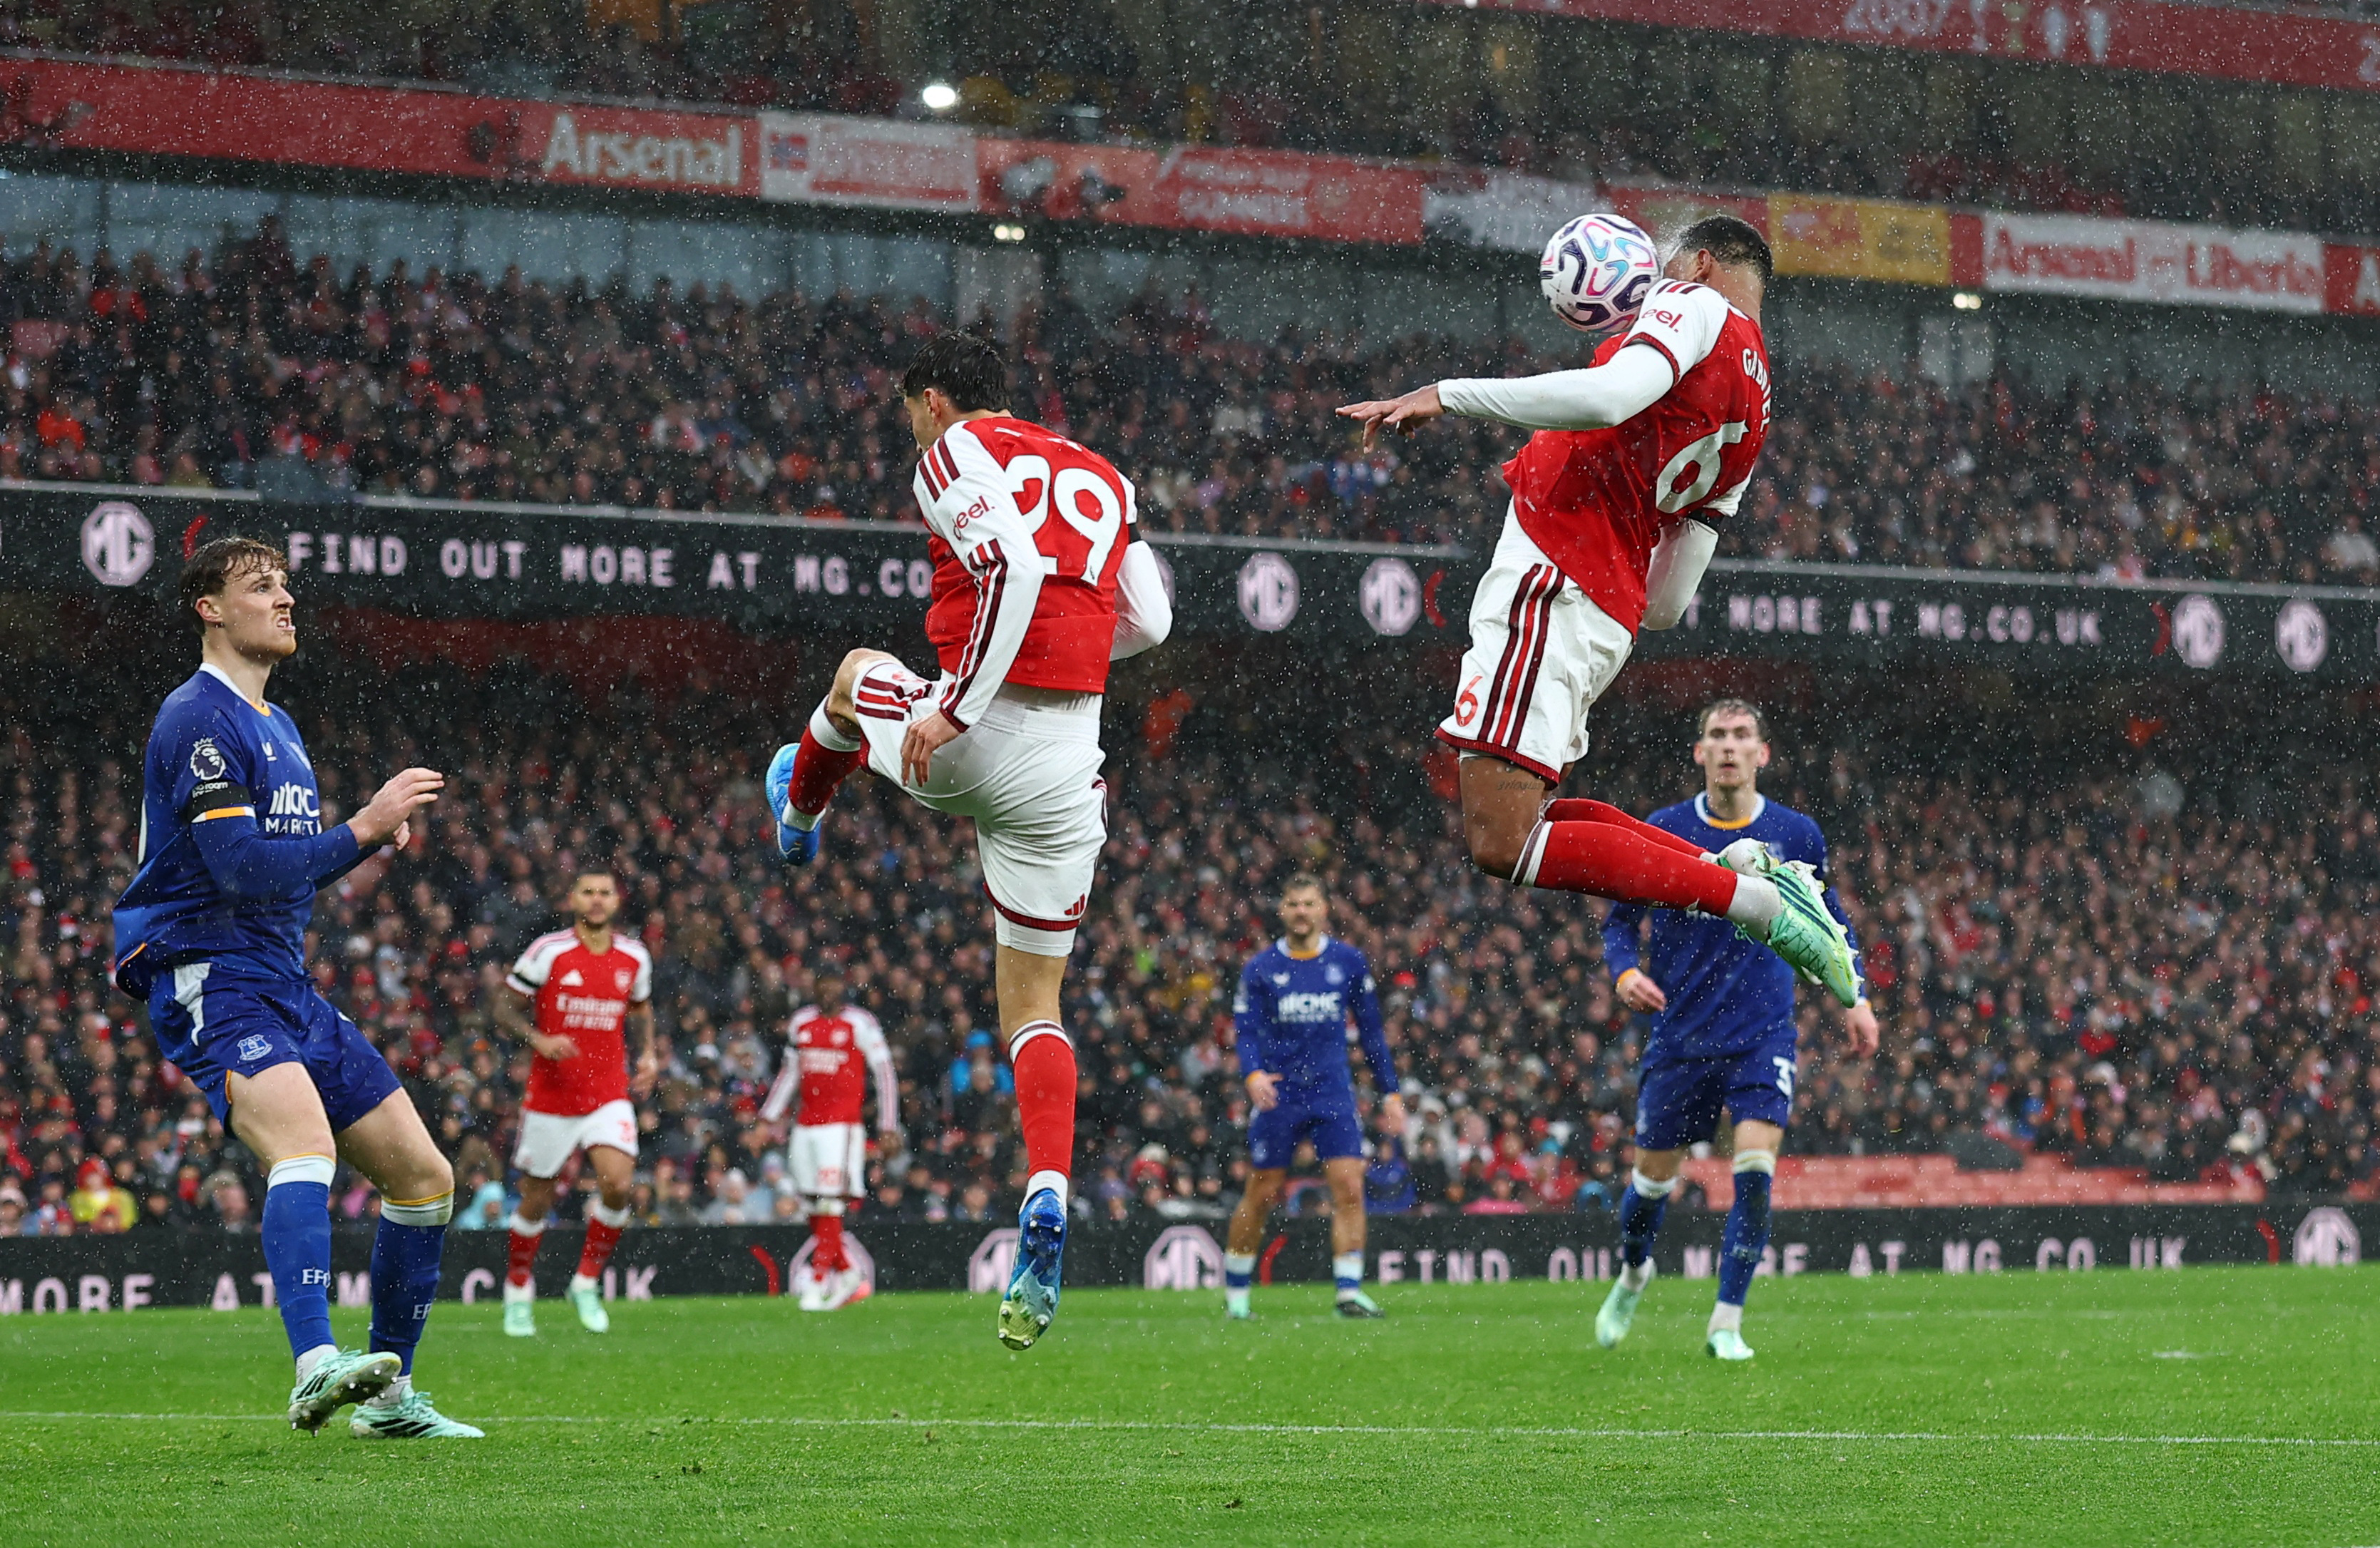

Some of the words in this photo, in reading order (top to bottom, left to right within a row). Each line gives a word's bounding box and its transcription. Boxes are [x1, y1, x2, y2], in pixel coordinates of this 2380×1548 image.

[544, 112, 742, 187] Arsenal
[1656, 419, 1750, 514] 6
[83, 504, 153, 584] MG
[1005, 454, 1122, 587] 29
[288, 531, 408, 576] FIND
[439, 538, 526, 580] OUT
[560, 543, 677, 589] MORE
[707, 550, 762, 591] AT
[794, 554, 933, 599] MG.CO
[1728, 595, 1822, 636] MORE
[1848, 599, 1893, 637] AT
[1918, 602, 2102, 645] MG.CO.UK
[1455, 675, 1483, 727] 6
[212, 1271, 277, 1311] AT
[1549, 1246, 1625, 1282] OU
[1850, 1241, 1907, 1277] AT
[412, 1303, 432, 1320] EF
